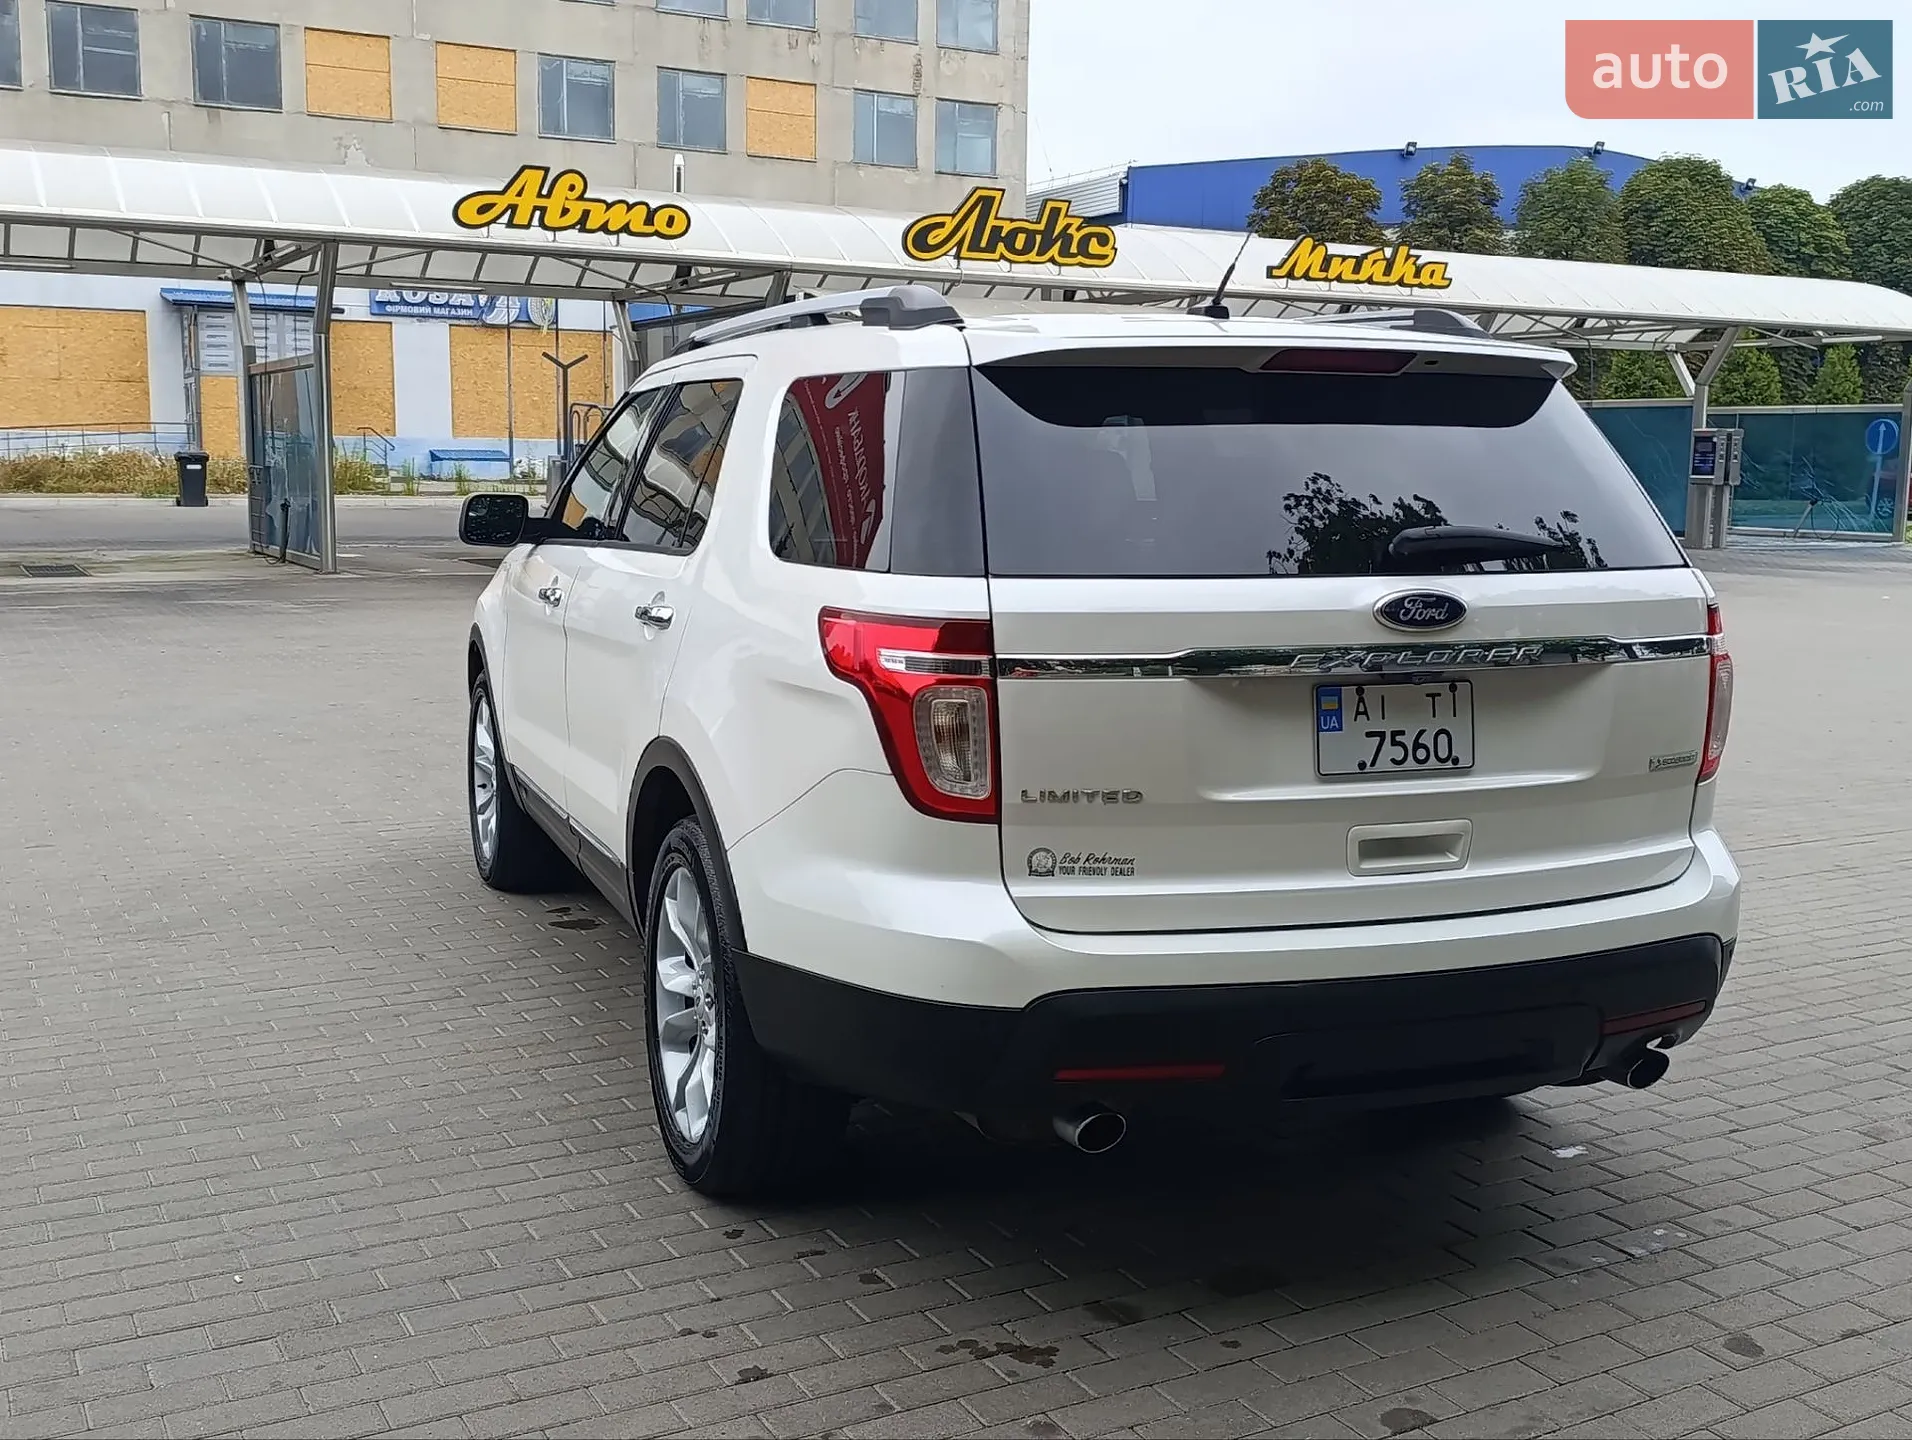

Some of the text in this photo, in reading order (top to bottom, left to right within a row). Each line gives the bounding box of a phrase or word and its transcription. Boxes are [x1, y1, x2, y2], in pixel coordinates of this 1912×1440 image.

[452, 164, 691, 240] Авто
[902, 186, 1117, 268] Люкс
[1267, 234, 1453, 289] Мийка
[385, 304, 473, 317] ФІРМОВИЙ МАГАЗИН
[1399, 596, 1451, 622] Ford
[1289, 646, 1545, 670] EXPLORER
[1320, 715, 1339, 730] UA
[1365, 728, 1454, 768] 7560
[1020, 788, 1143, 804] LIMITED
[1058, 865, 1076, 876] YOUR
[1078, 866, 1108, 876] FRIENDLY
[1110, 866, 1135, 877] DEALER
[1059, 851, 1136, 867] Bob Rohrman
